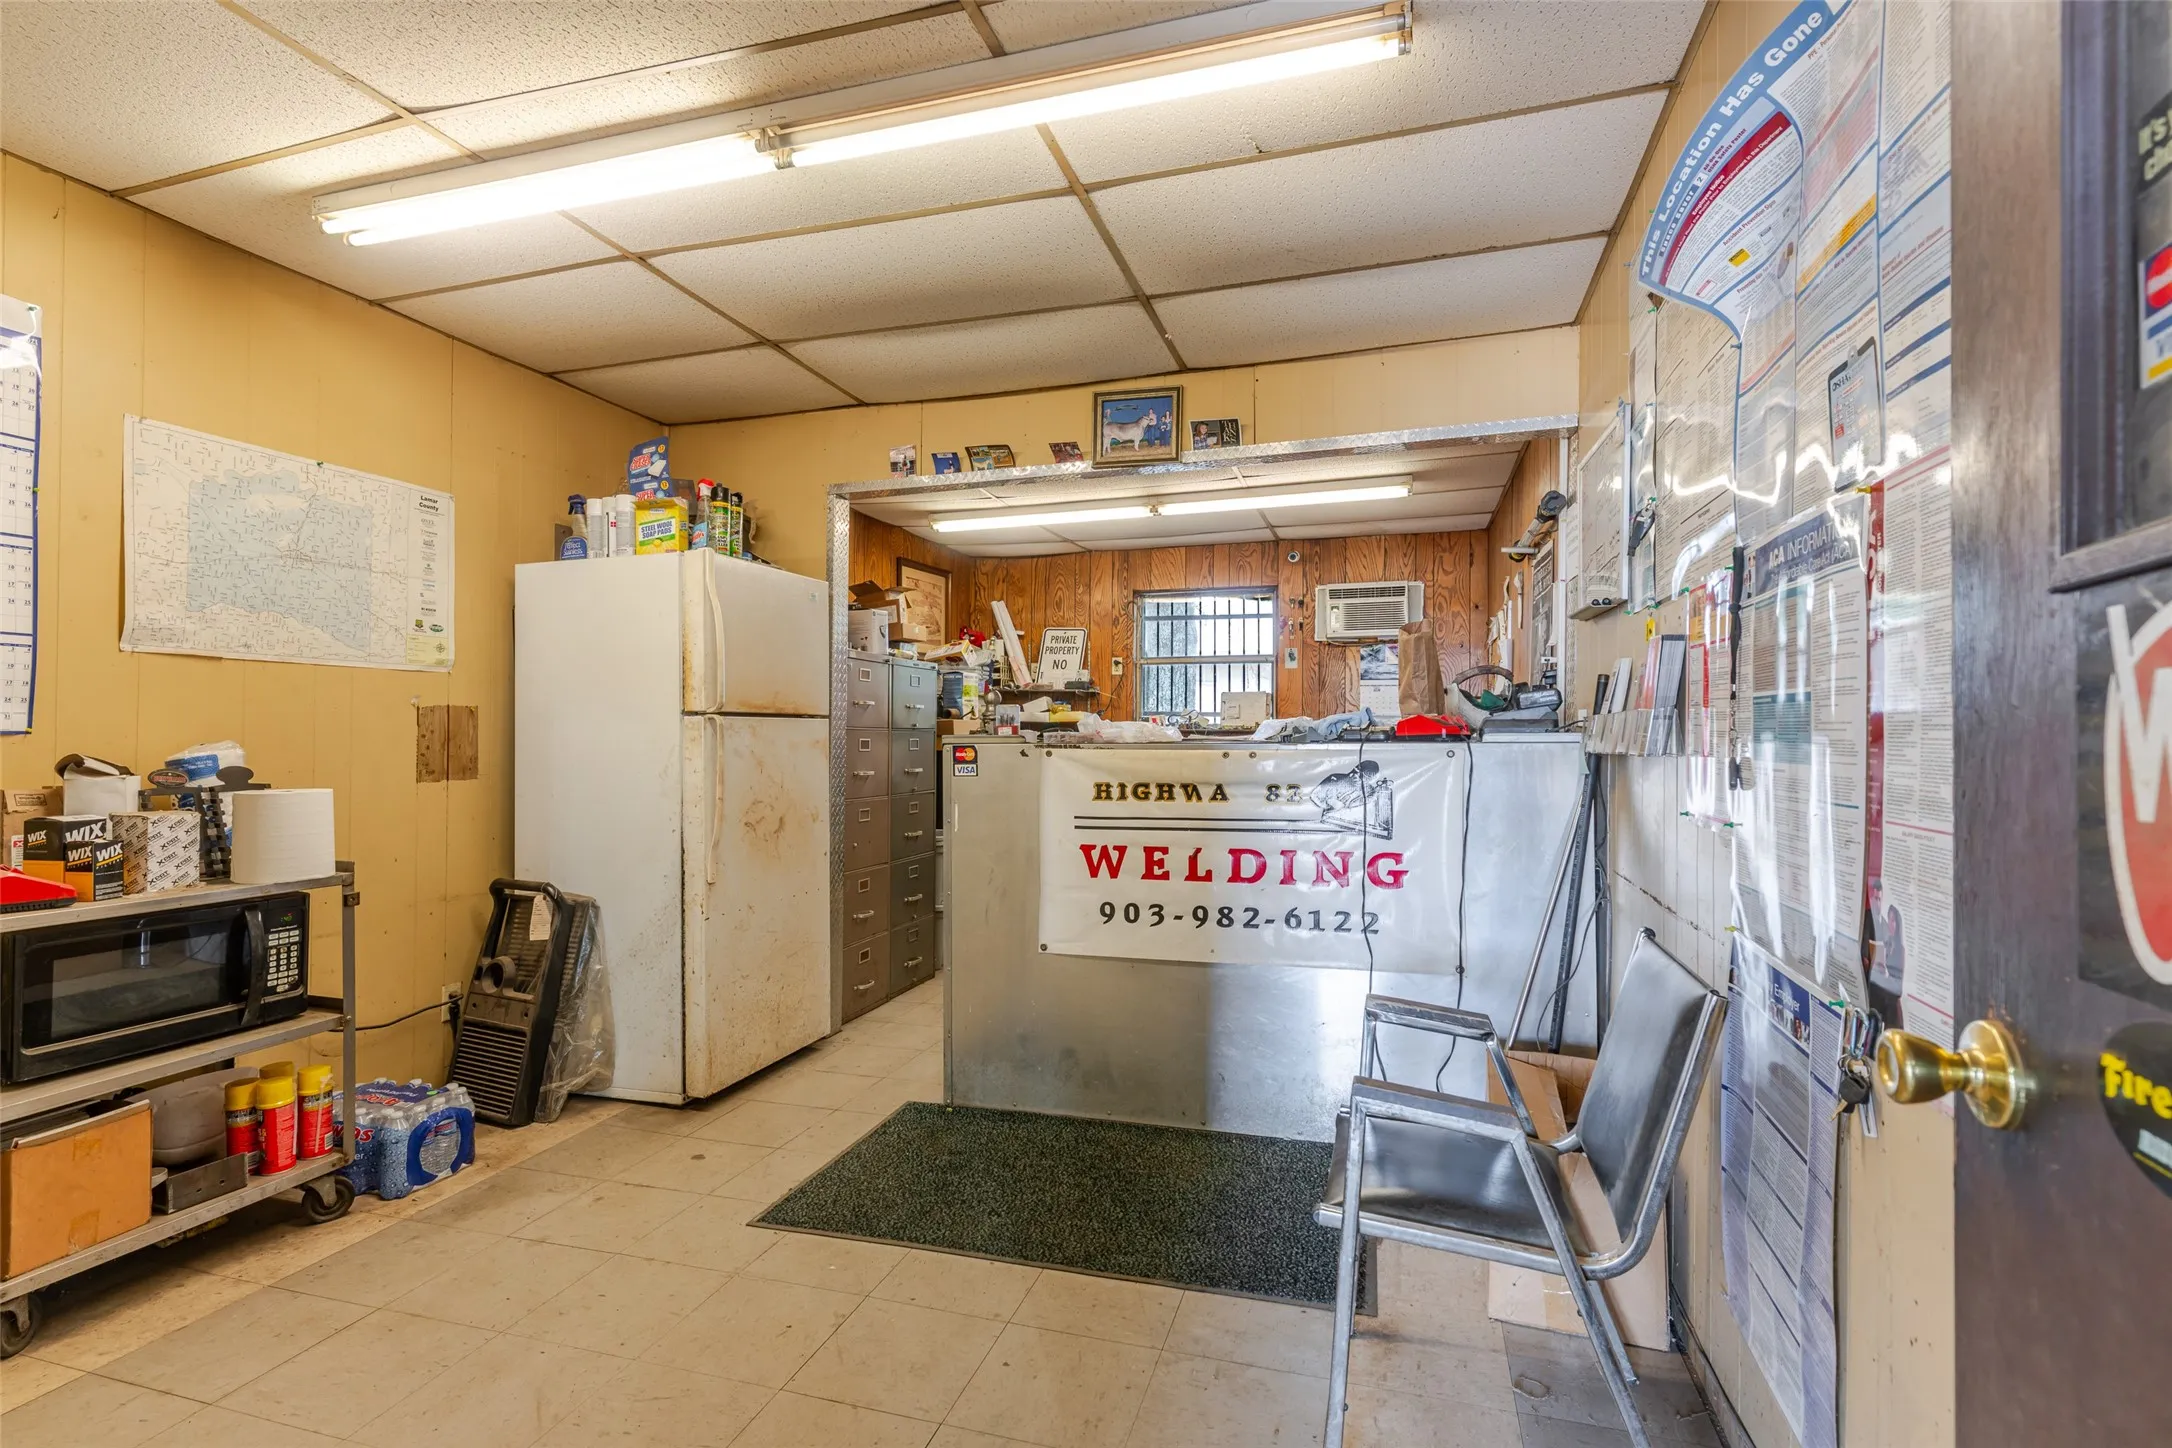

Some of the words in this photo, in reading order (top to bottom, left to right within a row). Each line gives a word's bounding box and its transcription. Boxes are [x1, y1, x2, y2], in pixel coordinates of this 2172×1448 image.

[1642, 230, 1661, 278] This
[1658, 122, 1723, 222] Location
[1719, 71, 1765, 118] Has
[1764, 11, 1823, 68] Gone
[1718, 144, 1733, 160] Safety
[1732, 128, 1748, 144] Poster
[1722, 158, 1748, 186] Employment
[1758, 126, 1784, 150] Department
[1692, 186, 1714, 216] Employee
[1711, 174, 1726, 190] Notice
[1722, 226, 1743, 247] Accident
[1742, 206, 1766, 231] Prevention
[418, 502, 439, 512] County
[420, 495, 438, 504] Lamar
[641, 524, 656, 533] STEEL
[656, 520, 673, 530] WOOL
[642, 530, 657, 540] SOAP
[657, 528, 672, 536] PADS
[1768, 545, 1785, 570] ACA
[1050, 636, 1078, 644] PRIVATE
[1044, 646, 1080, 655] PROPERTY
[1052, 660, 1068, 670] NO
[957, 766, 976, 774] VISA
[1092, 782, 1230, 804] HIGHWA
[1264, 783, 1304, 803] 82
[27, 830, 47, 843] WIX
[65, 822, 106, 842] WIX
[68, 846, 92, 862] WIX
[96, 842, 124, 862] WIX
[1079, 844, 1410, 890] WELDING
[1099, 901, 1381, 935] 903-982-6122
[2100, 1052, 2172, 1120] Fire
